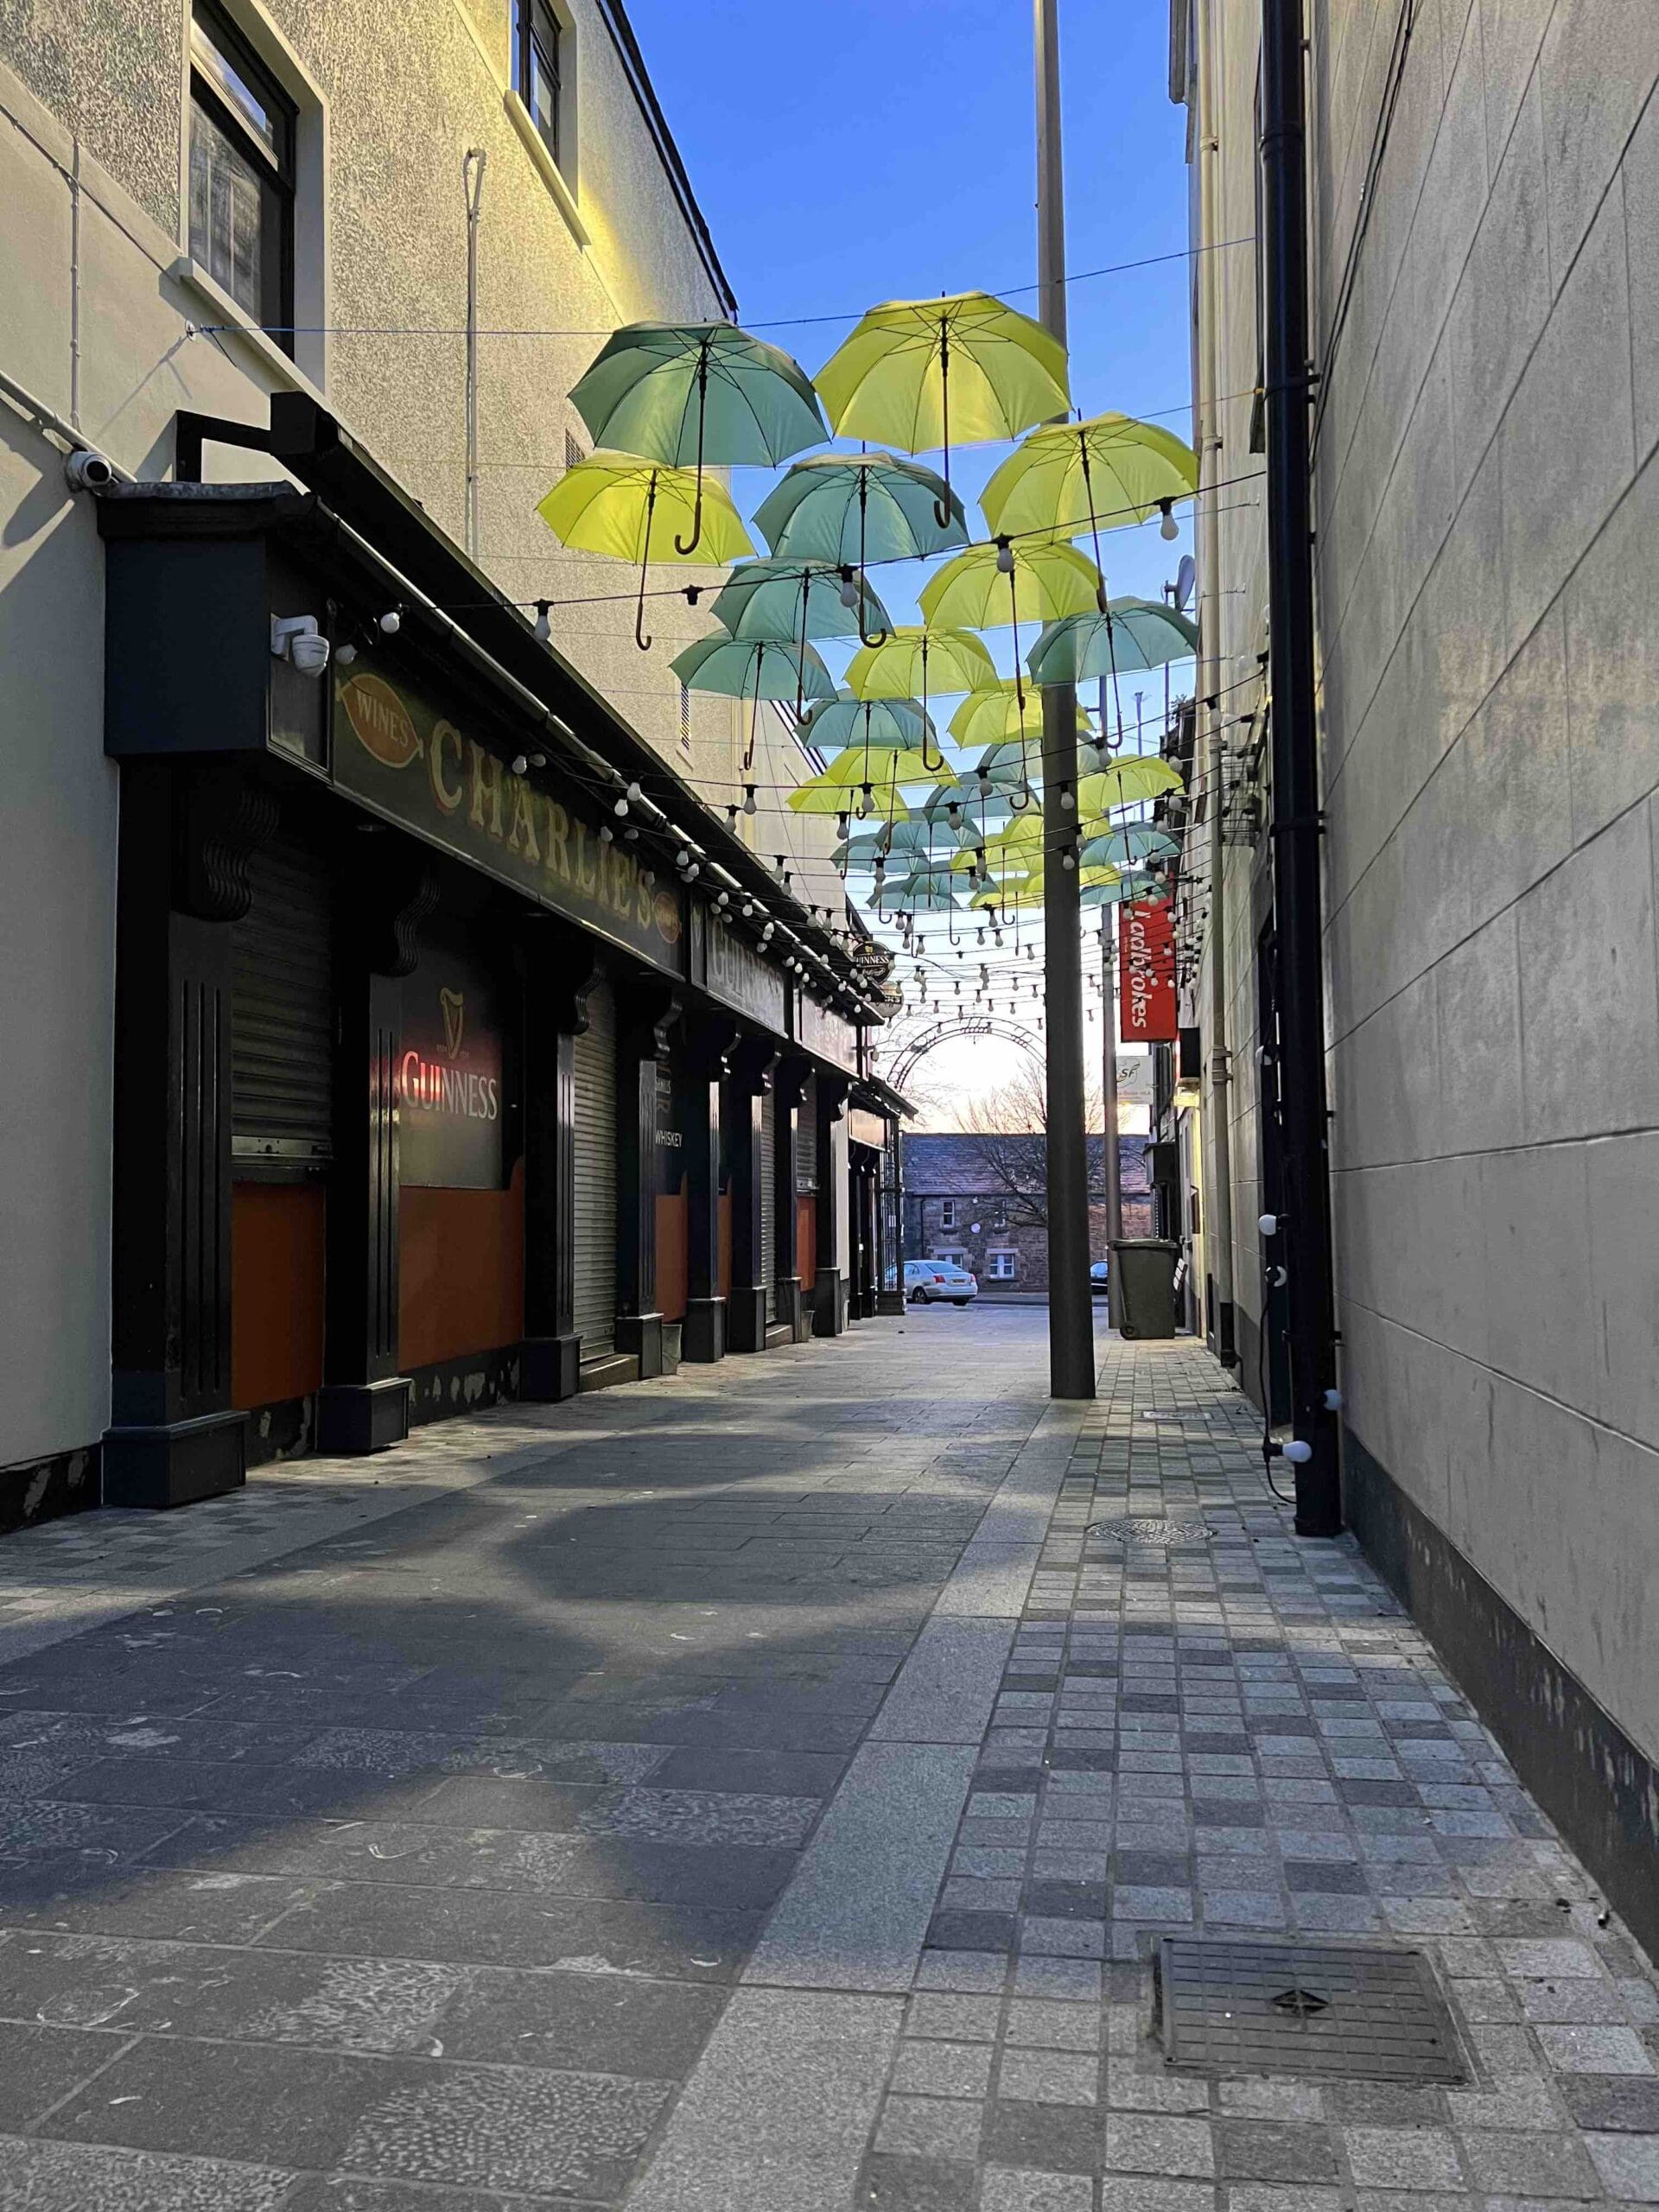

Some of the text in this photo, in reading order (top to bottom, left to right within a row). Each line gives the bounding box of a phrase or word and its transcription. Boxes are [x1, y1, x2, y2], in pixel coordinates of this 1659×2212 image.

[356, 689, 409, 748] WINES
[429, 718, 652, 930] CHARLIE'S
[401, 1050, 498, 1121] GUINNESS
[655, 1128, 683, 1148] WHISKEY
